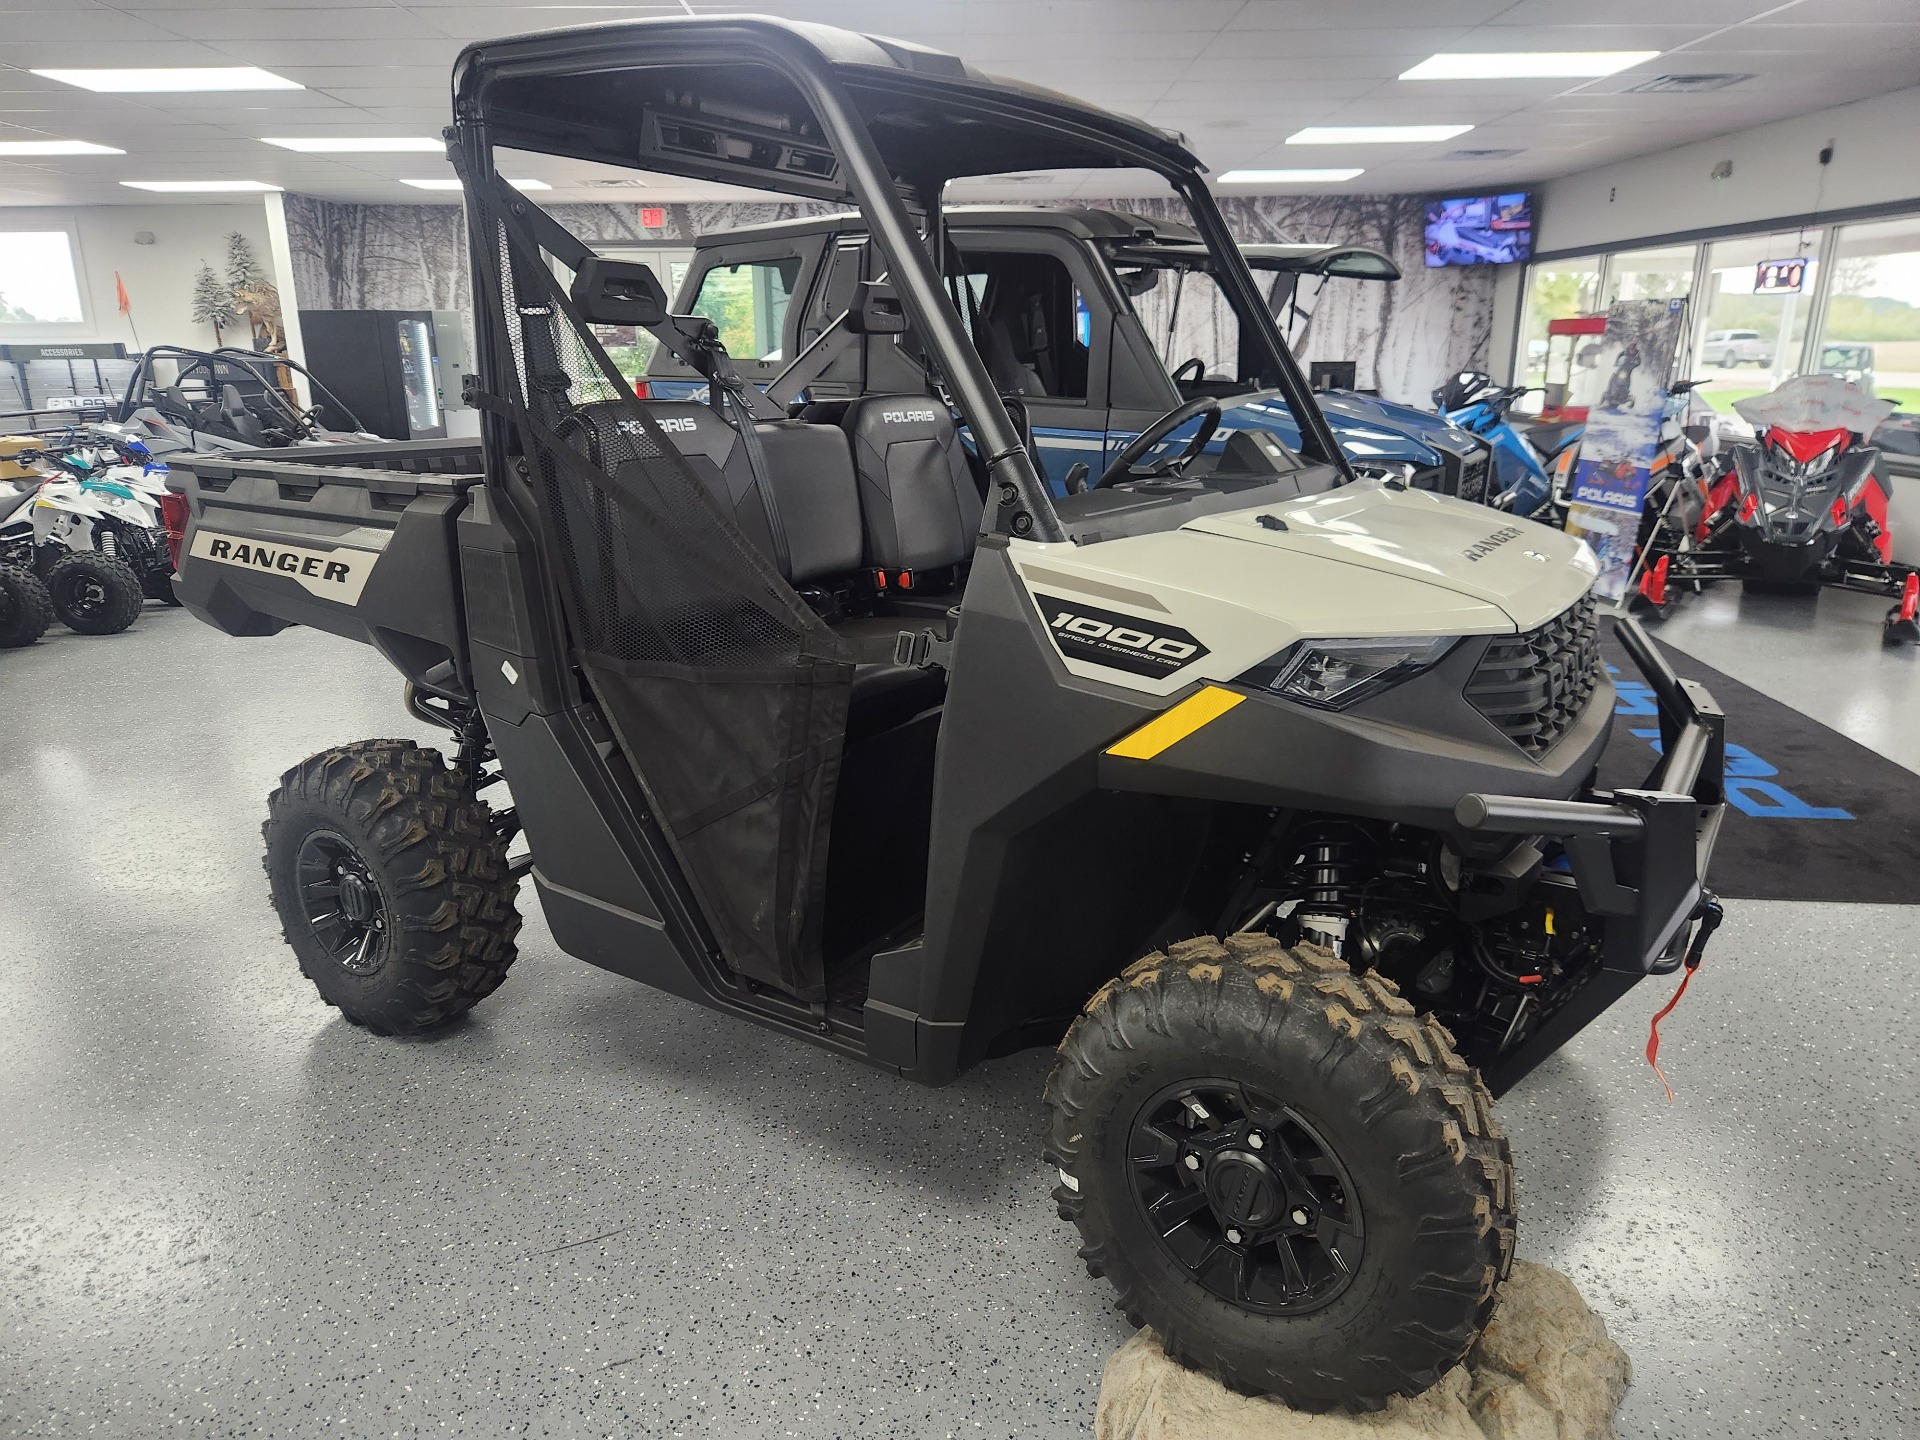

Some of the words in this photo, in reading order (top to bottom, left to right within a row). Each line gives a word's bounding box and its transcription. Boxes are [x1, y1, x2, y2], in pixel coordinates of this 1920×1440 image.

[40, 348, 84, 357] ACCESSORIES
[616, 417, 697, 435] POARIS
[882, 410, 936, 424] POLARIS
[1576, 486, 1638, 508] POLARIS
[1462, 526, 1525, 562] RANGER
[209, 539, 351, 583] RANGER
[1050, 612, 1198, 660] 1000
[1057, 631, 1097, 645] SINGLE
[1098, 642, 1156, 661] OVERHEAD
[1156, 657, 1182, 667] CAM
